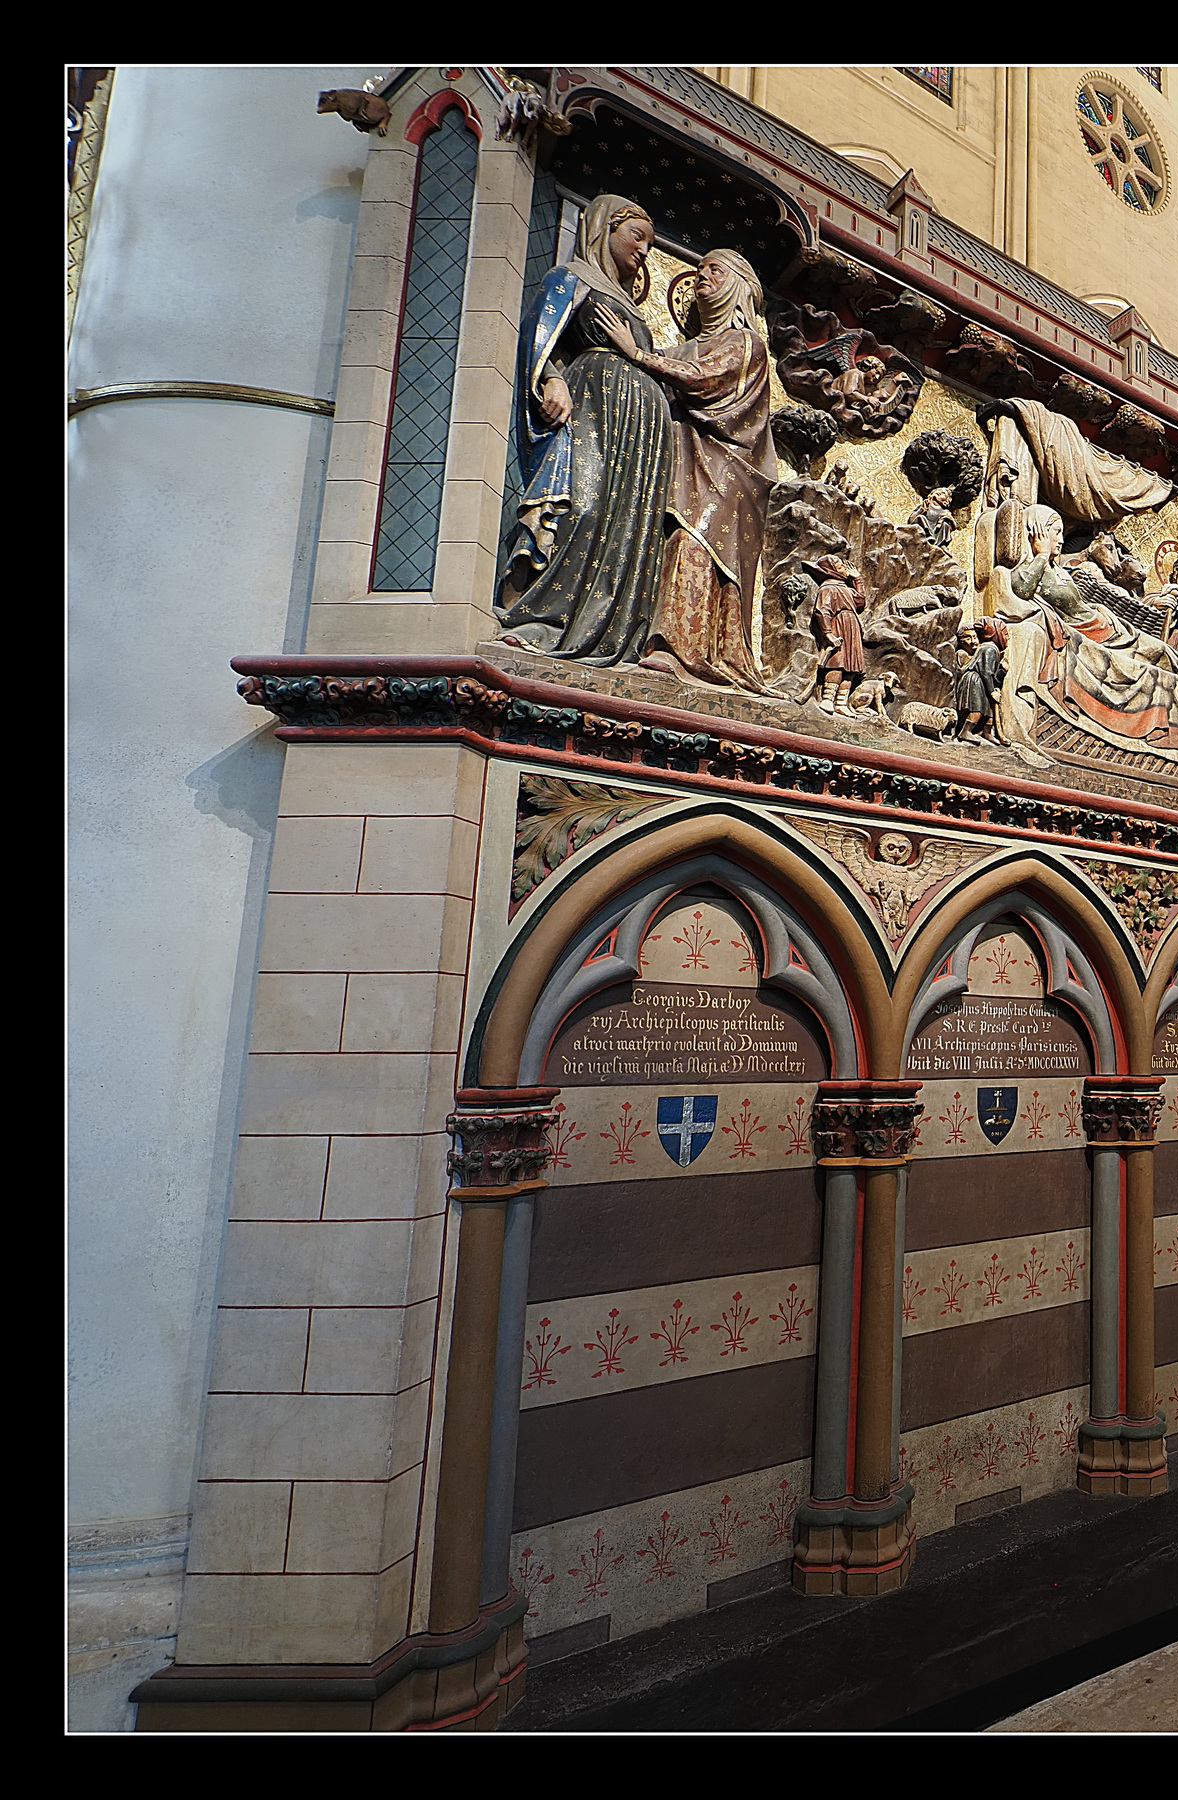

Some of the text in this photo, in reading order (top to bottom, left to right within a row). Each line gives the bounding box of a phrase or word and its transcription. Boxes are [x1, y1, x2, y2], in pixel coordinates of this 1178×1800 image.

[696, 989, 751, 1018] Darboy
[723, 1034, 737, 1051] ad
[1018, 1036, 1078, 1054] Parisiensis
[561, 1055, 584, 1075] die
